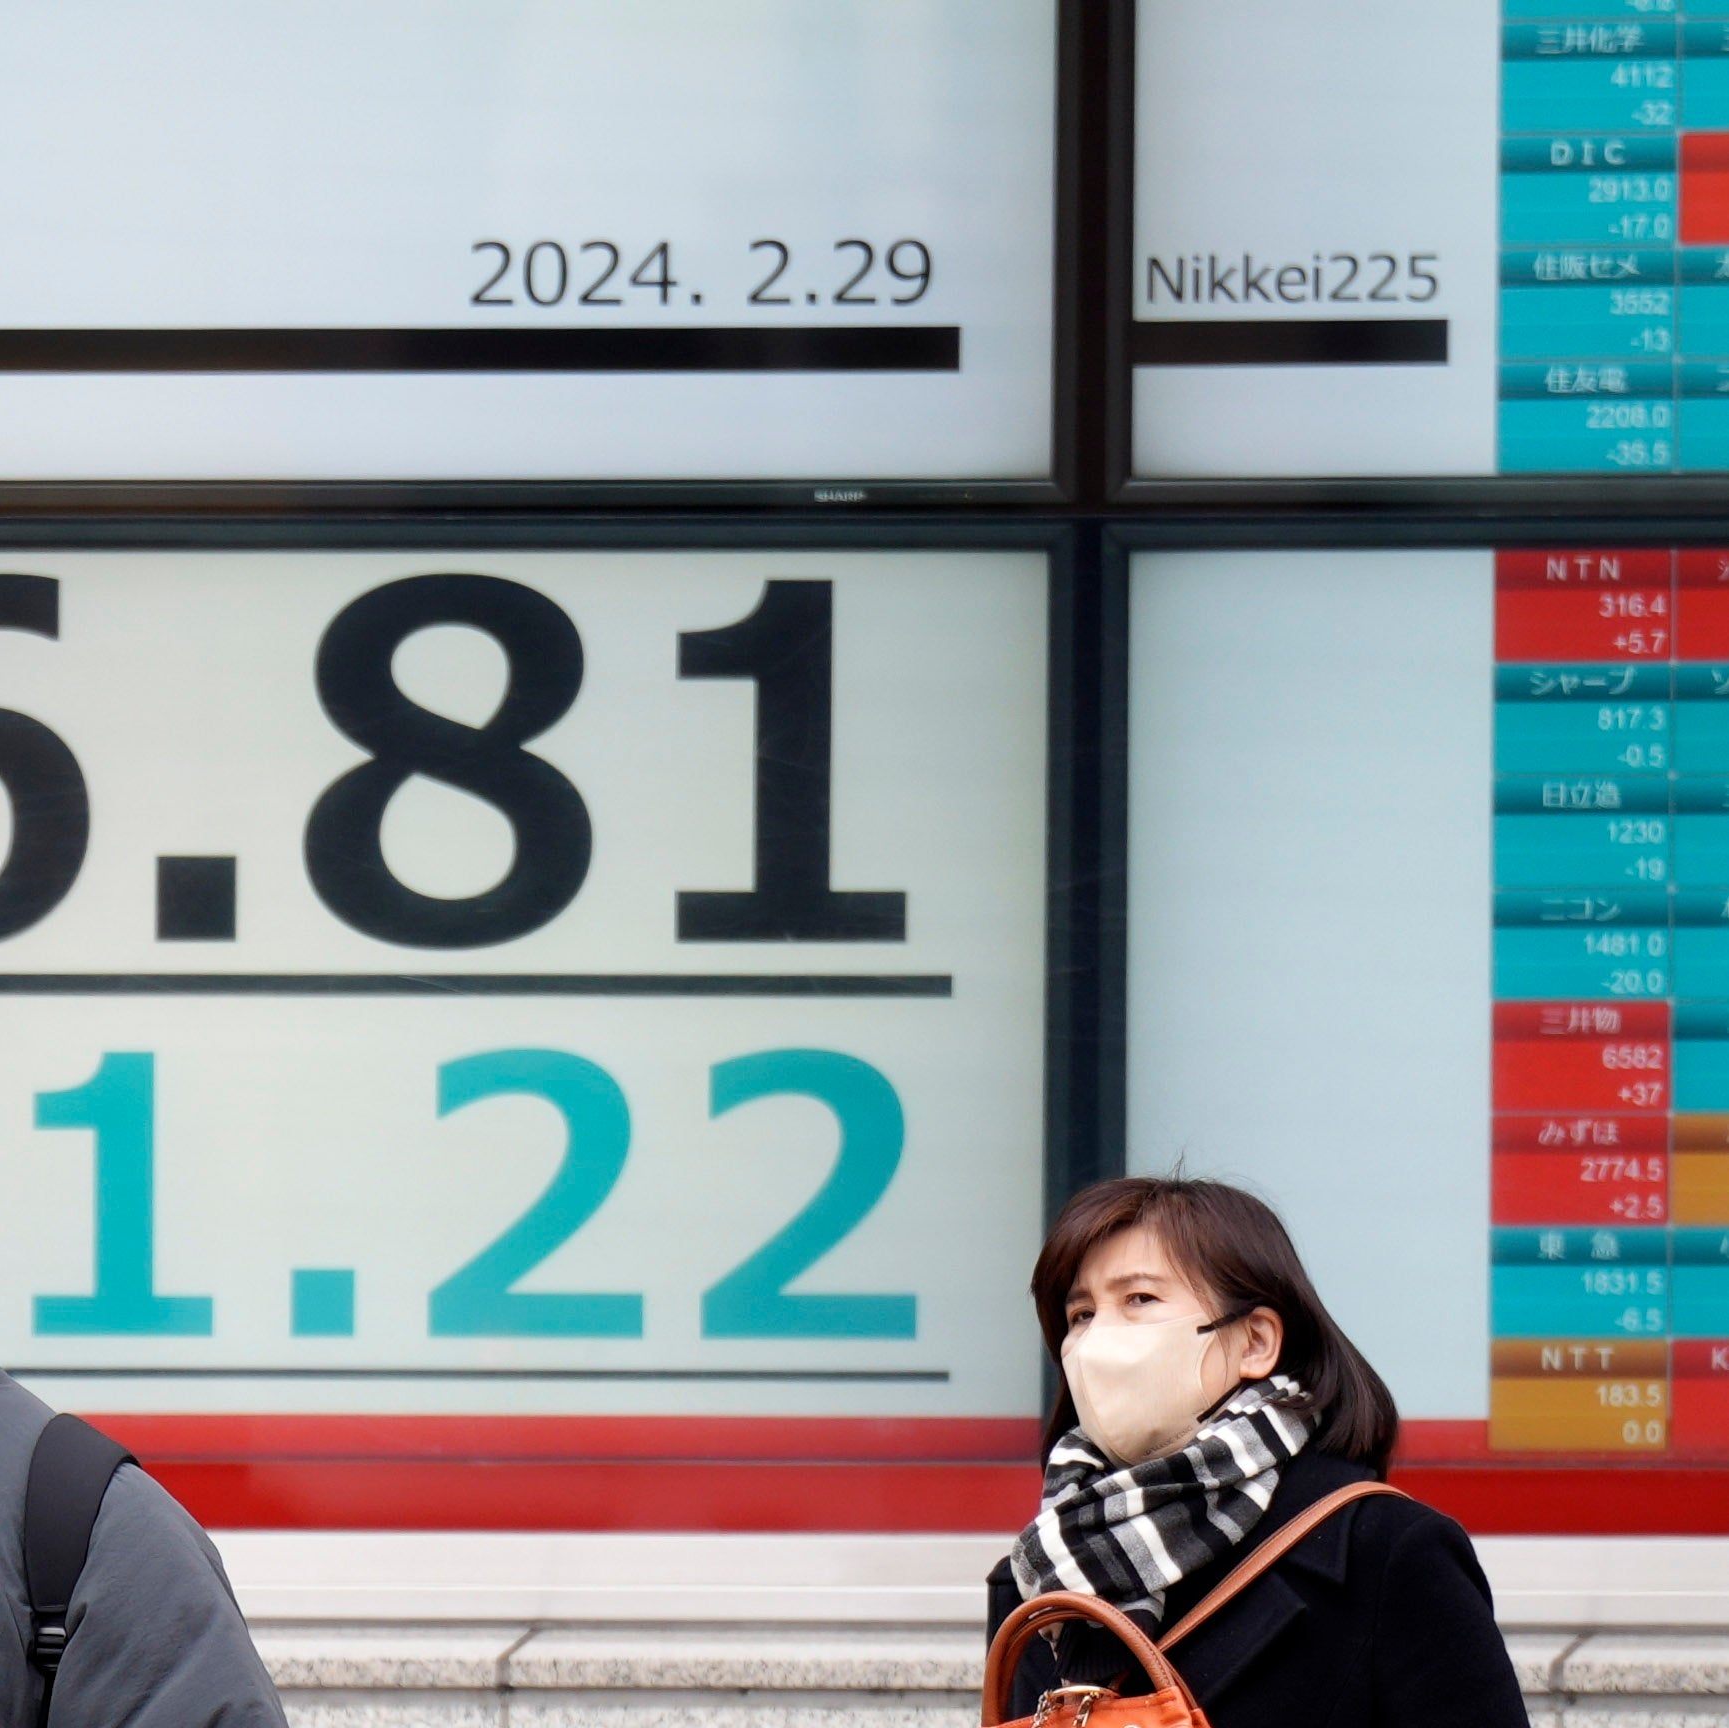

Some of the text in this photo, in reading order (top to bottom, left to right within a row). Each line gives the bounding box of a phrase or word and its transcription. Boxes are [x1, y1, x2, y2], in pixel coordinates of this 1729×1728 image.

[1535, 26, 1643, 54] 三井化学
[748, 238, 933, 308] 2.29
[1146, 250, 1440, 305] Nikkei225
[1546, 557, 1621, 582] NTN
[1530, 665, 1637, 695] シャープ
[1540, 1006, 1621, 1034] 三井物
[1541, 1346, 1614, 1371] NTT
